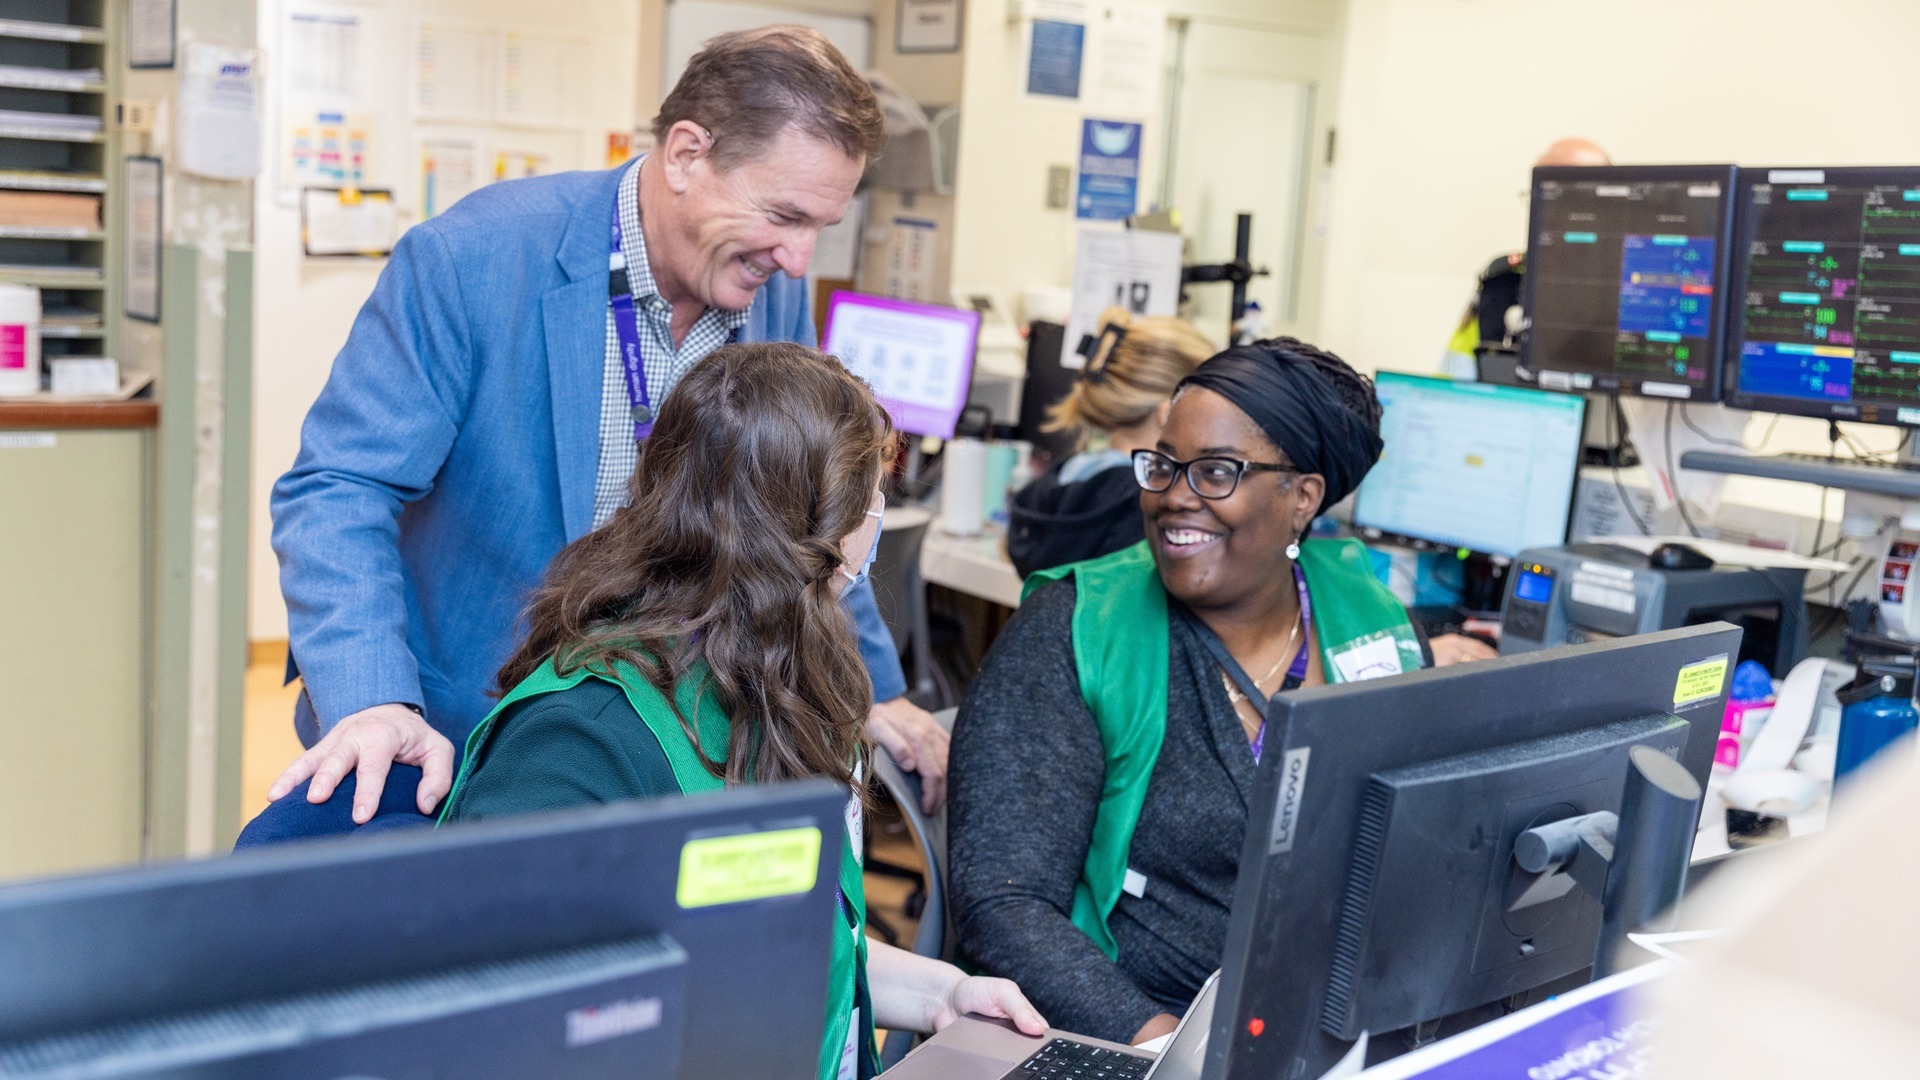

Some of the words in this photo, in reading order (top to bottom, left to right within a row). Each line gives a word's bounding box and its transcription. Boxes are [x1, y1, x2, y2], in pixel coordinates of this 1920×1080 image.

[626, 342, 639, 371] dignity
[632, 371, 643, 402] human
[1275, 758, 1301, 844] Lenovo
